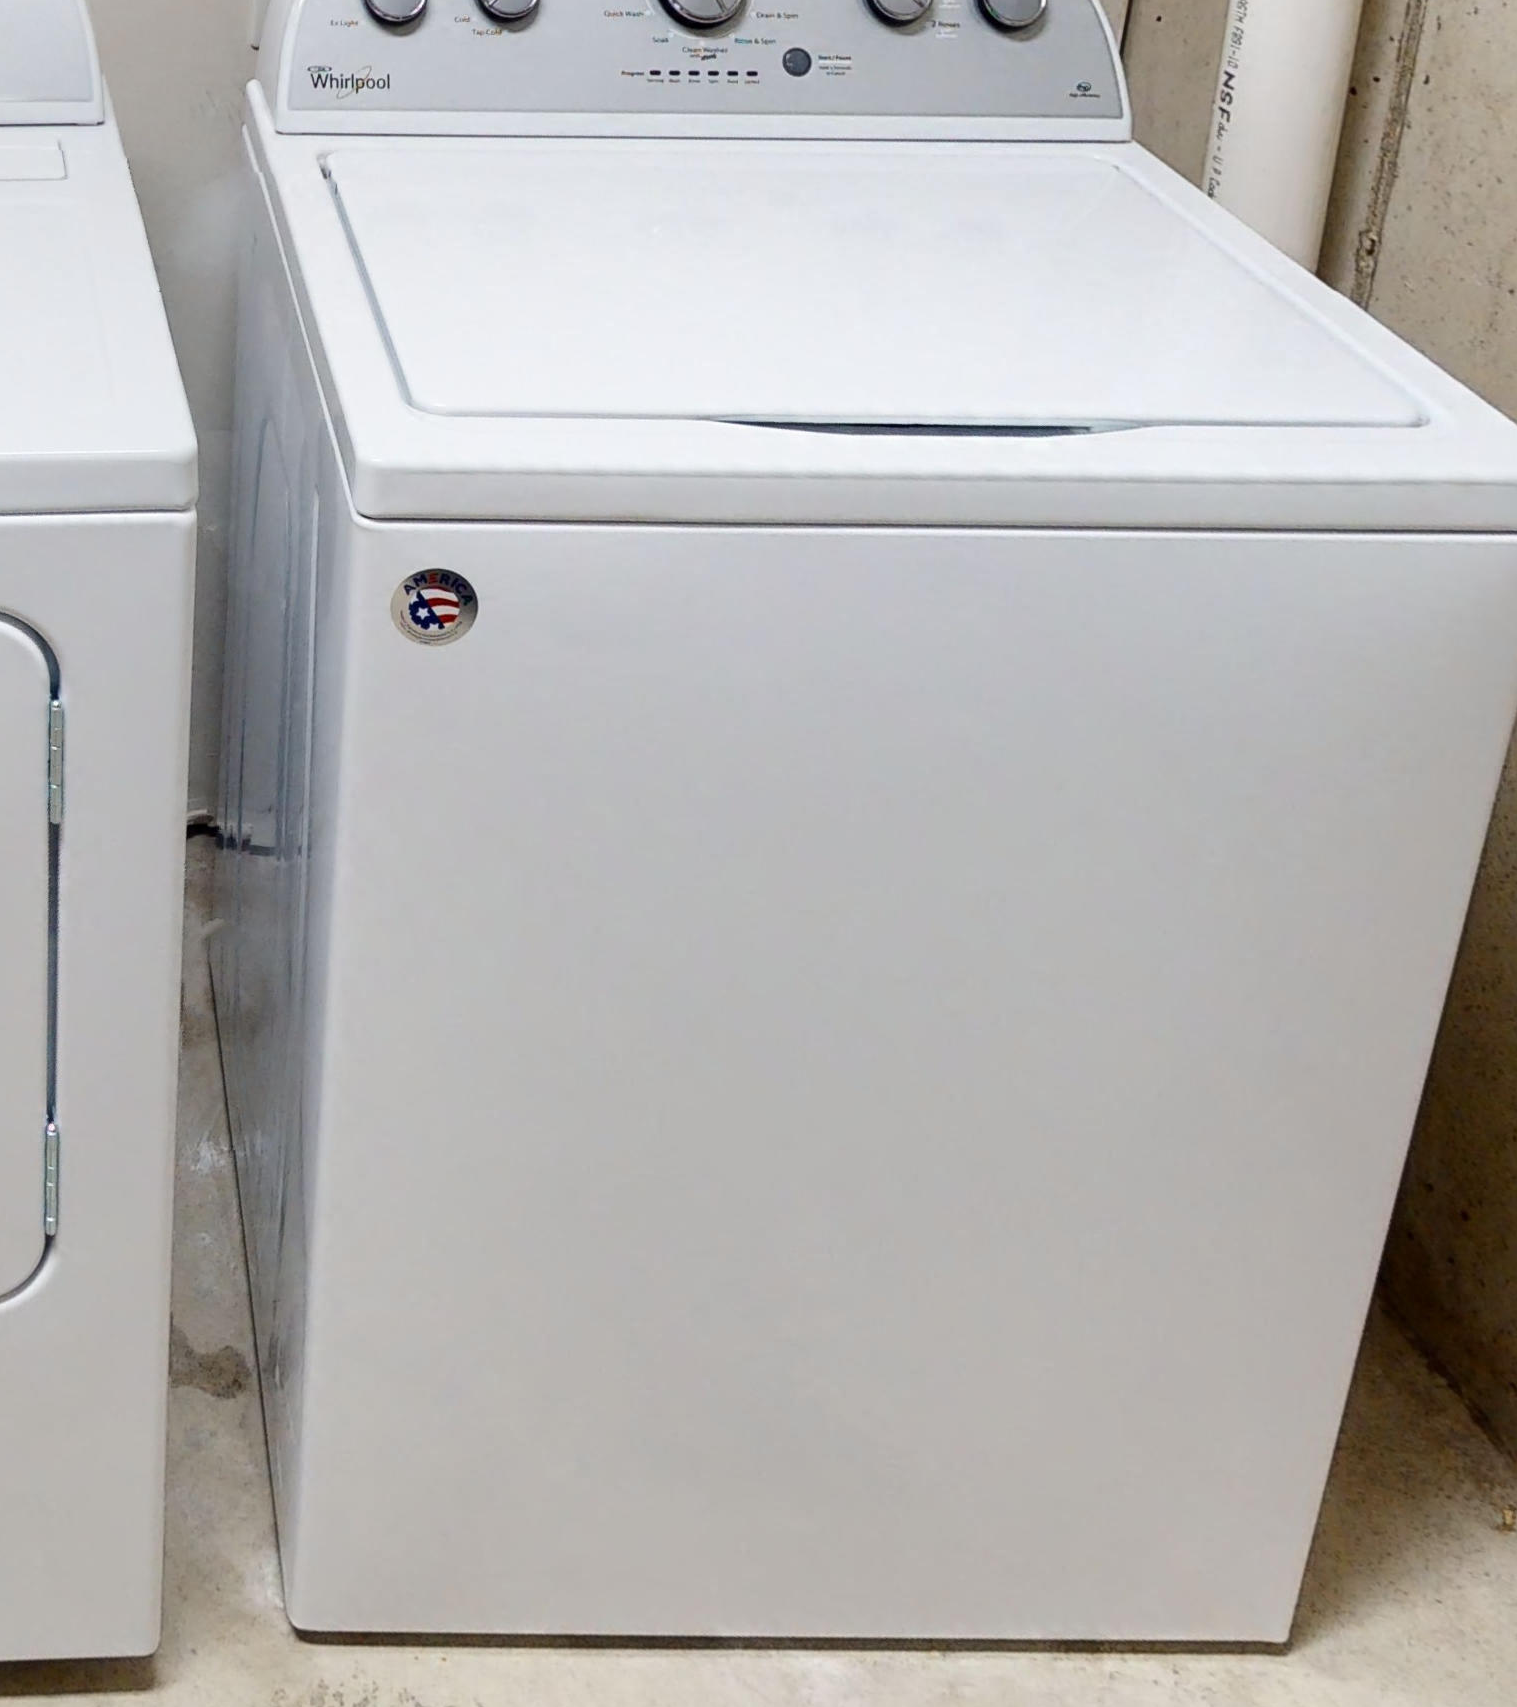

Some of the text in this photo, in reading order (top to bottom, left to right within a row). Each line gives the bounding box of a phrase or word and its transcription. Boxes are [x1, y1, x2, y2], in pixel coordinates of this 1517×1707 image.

[310, 73, 390, 94] Whirlpool
[1218, 70, 1236, 123] NSF
[403, 572, 474, 606] AMERICA
